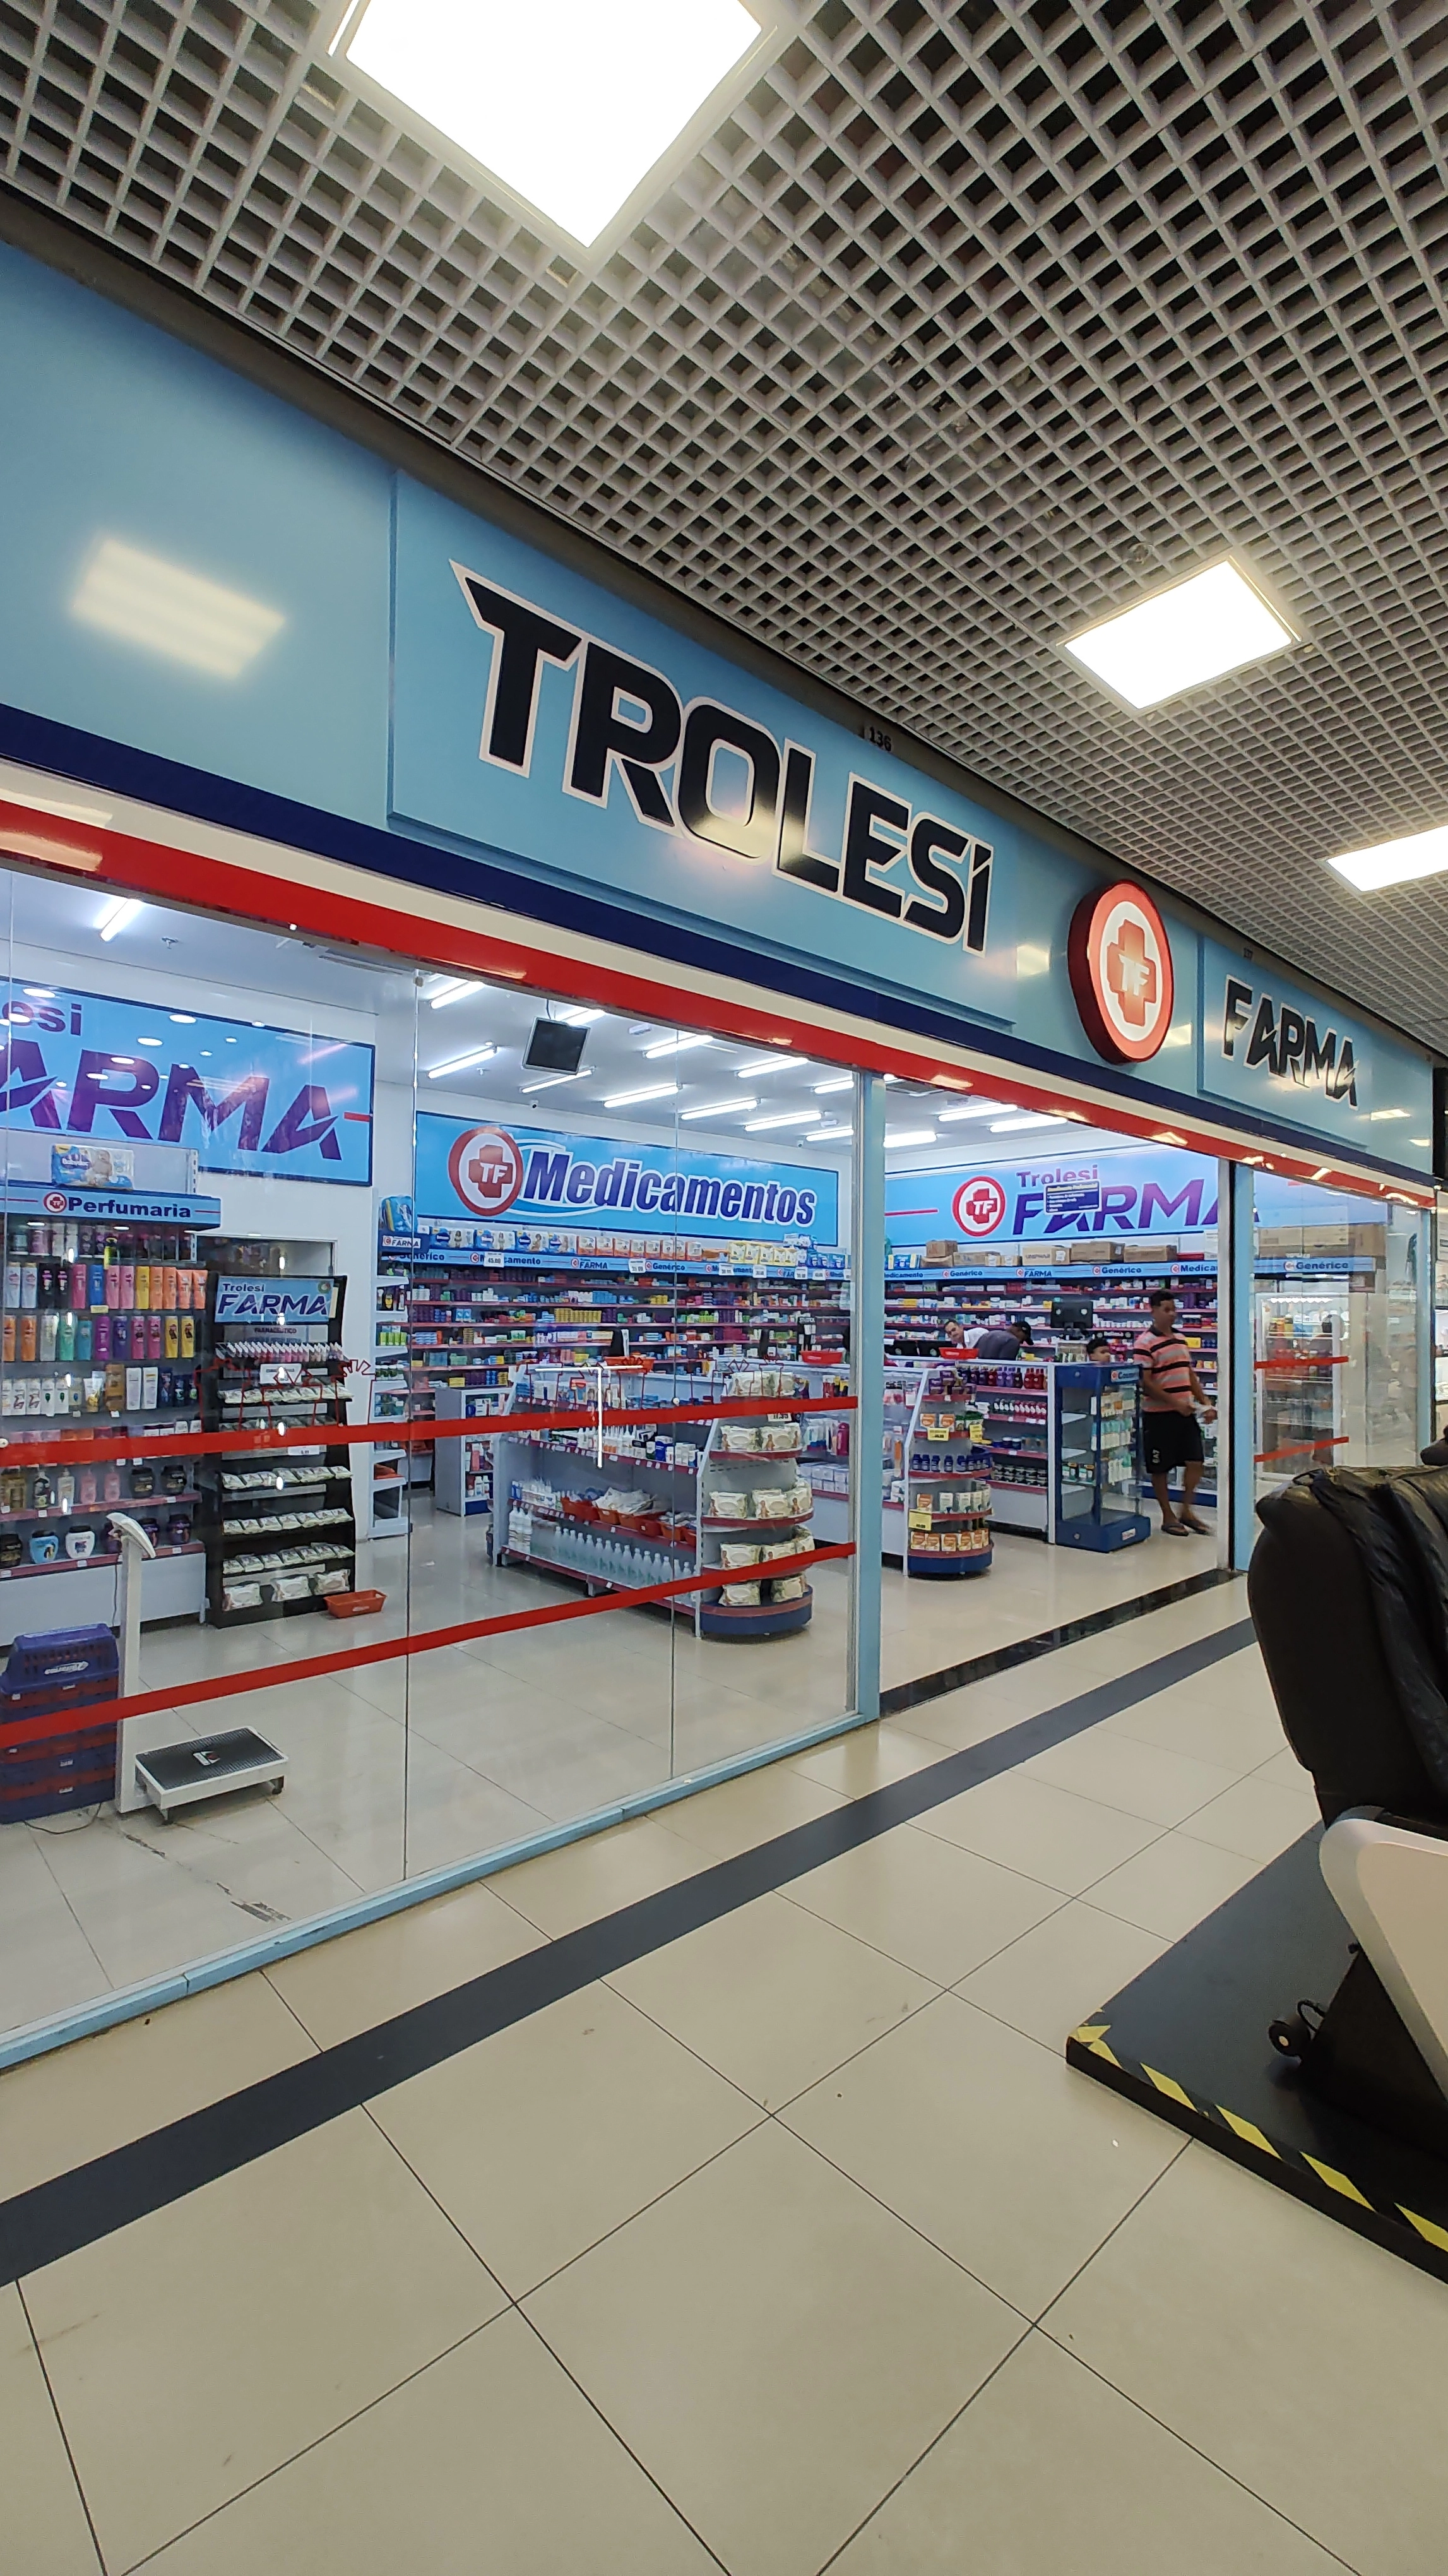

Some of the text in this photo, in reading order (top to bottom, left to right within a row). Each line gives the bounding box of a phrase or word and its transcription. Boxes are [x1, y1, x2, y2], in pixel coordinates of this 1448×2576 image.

[870, 726, 892, 752] 136
[1118, 953, 1150, 996] TF
[1221, 975, 1358, 1110] FARMA
[479, 1162, 507, 1184] TF
[1016, 1164, 1098, 1188] Trolesi
[523, 1150, 816, 1225] Medicamentos
[68, 1196, 191, 1218] Perfumaria
[974, 1200, 994, 1215] TF
[1180, 1264, 1218, 1272] Medica
[1296, 1261, 1349, 1270] Genérico
[222, 1283, 265, 1292] Trolesi
[217, 1294, 328, 1315] FARMA
